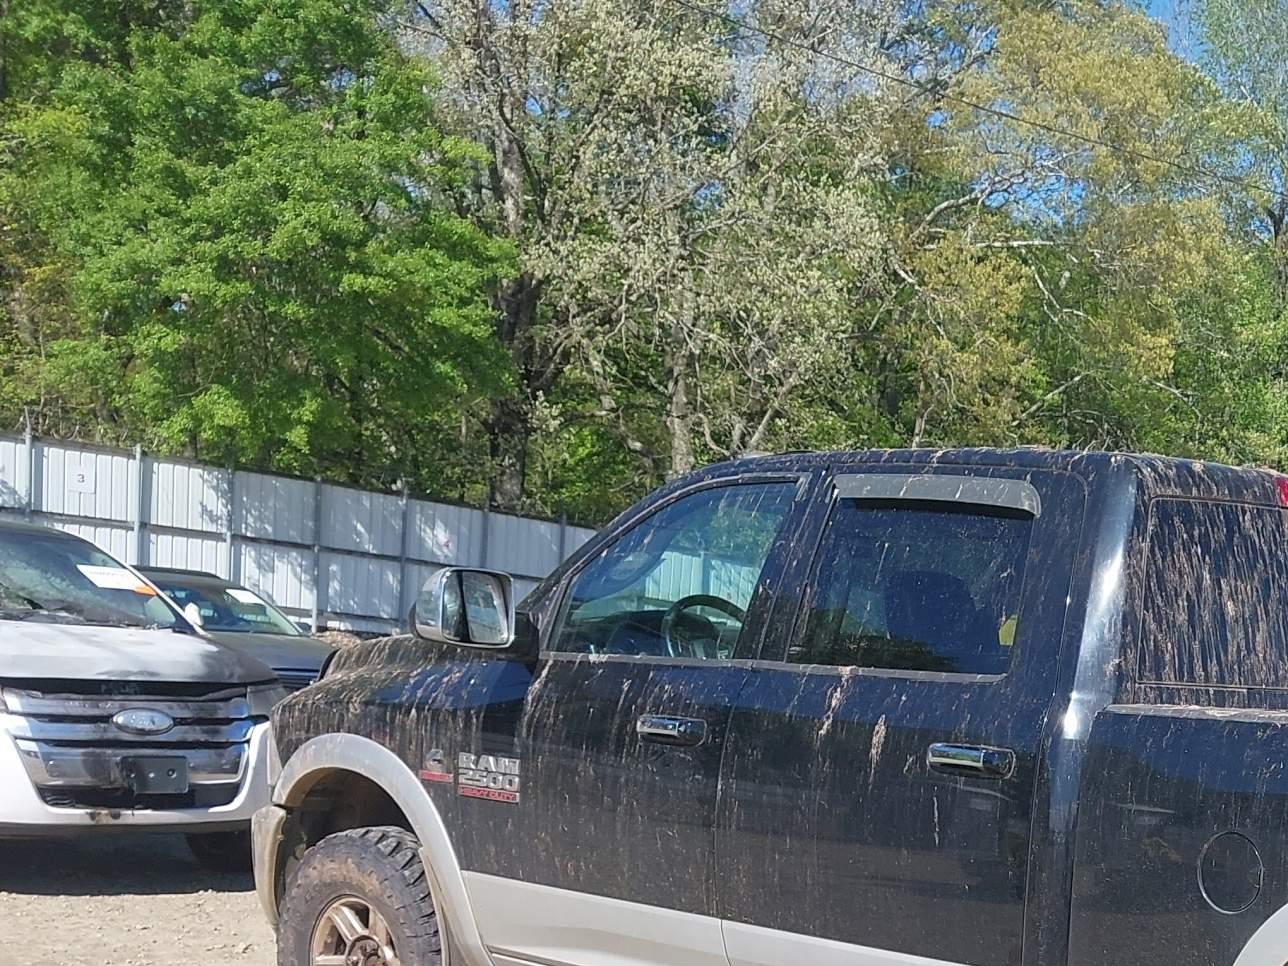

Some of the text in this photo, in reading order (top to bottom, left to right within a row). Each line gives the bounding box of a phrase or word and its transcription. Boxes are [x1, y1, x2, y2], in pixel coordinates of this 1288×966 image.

[76, 473, 85, 483] 3
[459, 752, 520, 775] RAM
[459, 769, 520, 791] 2500
